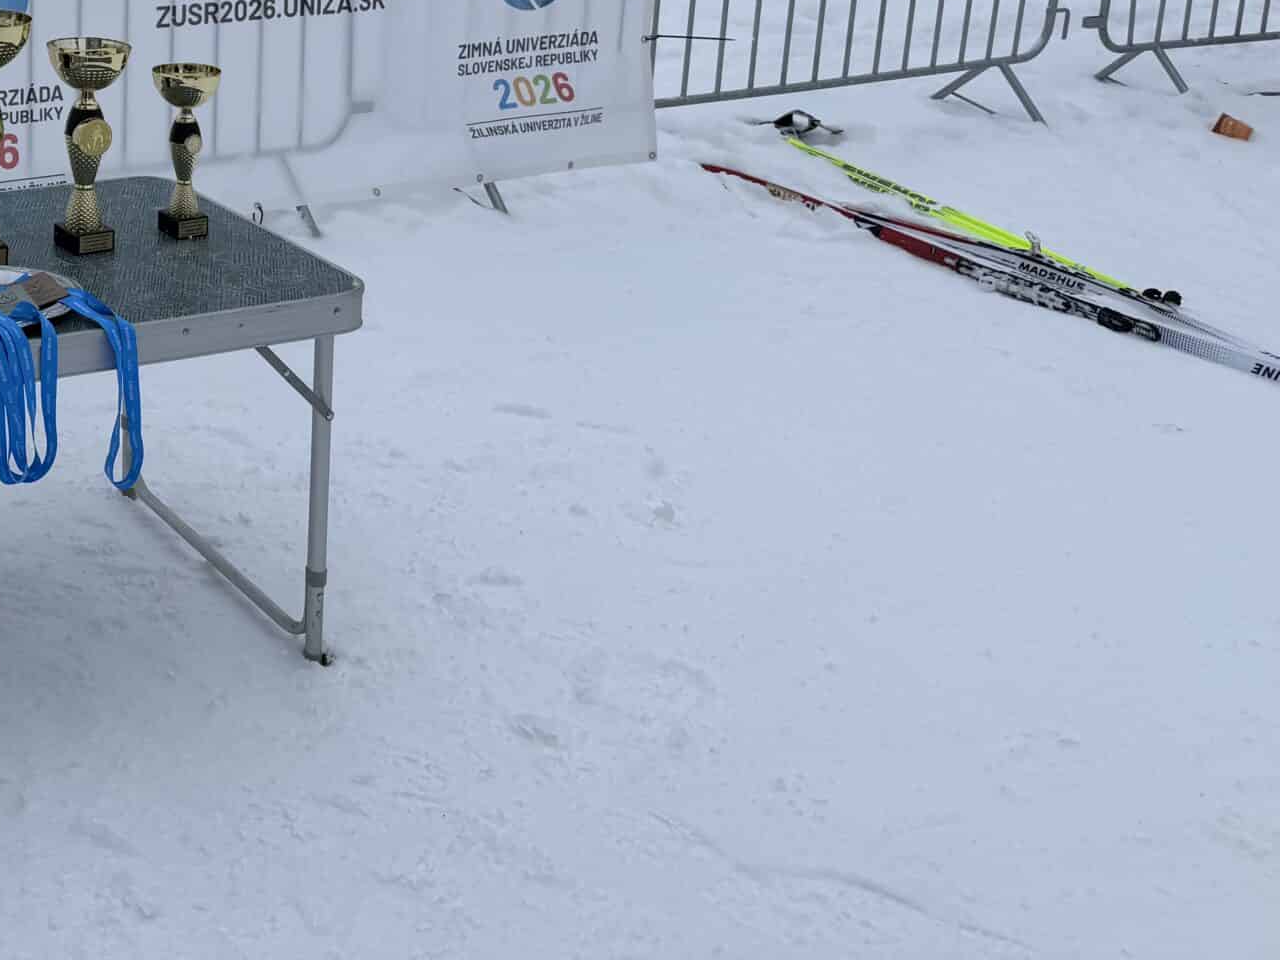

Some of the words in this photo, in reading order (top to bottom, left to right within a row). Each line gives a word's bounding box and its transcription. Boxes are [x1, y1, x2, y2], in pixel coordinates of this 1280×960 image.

[458, 37, 502, 60] ZIMNÁ
[506, 29, 598, 54] UNIVERZIÁDA
[457, 56, 533, 76] SLOVENSKEJ
[535, 49, 599, 67] REPUBLIKY
[493, 72, 575, 110] 2026
[470, 120, 519, 139] ŽILINSKÁ
[520, 117, 571, 133] UNIVERZITA
[574, 116, 580, 127] V
[1018, 261, 1087, 291] MADSHUS
